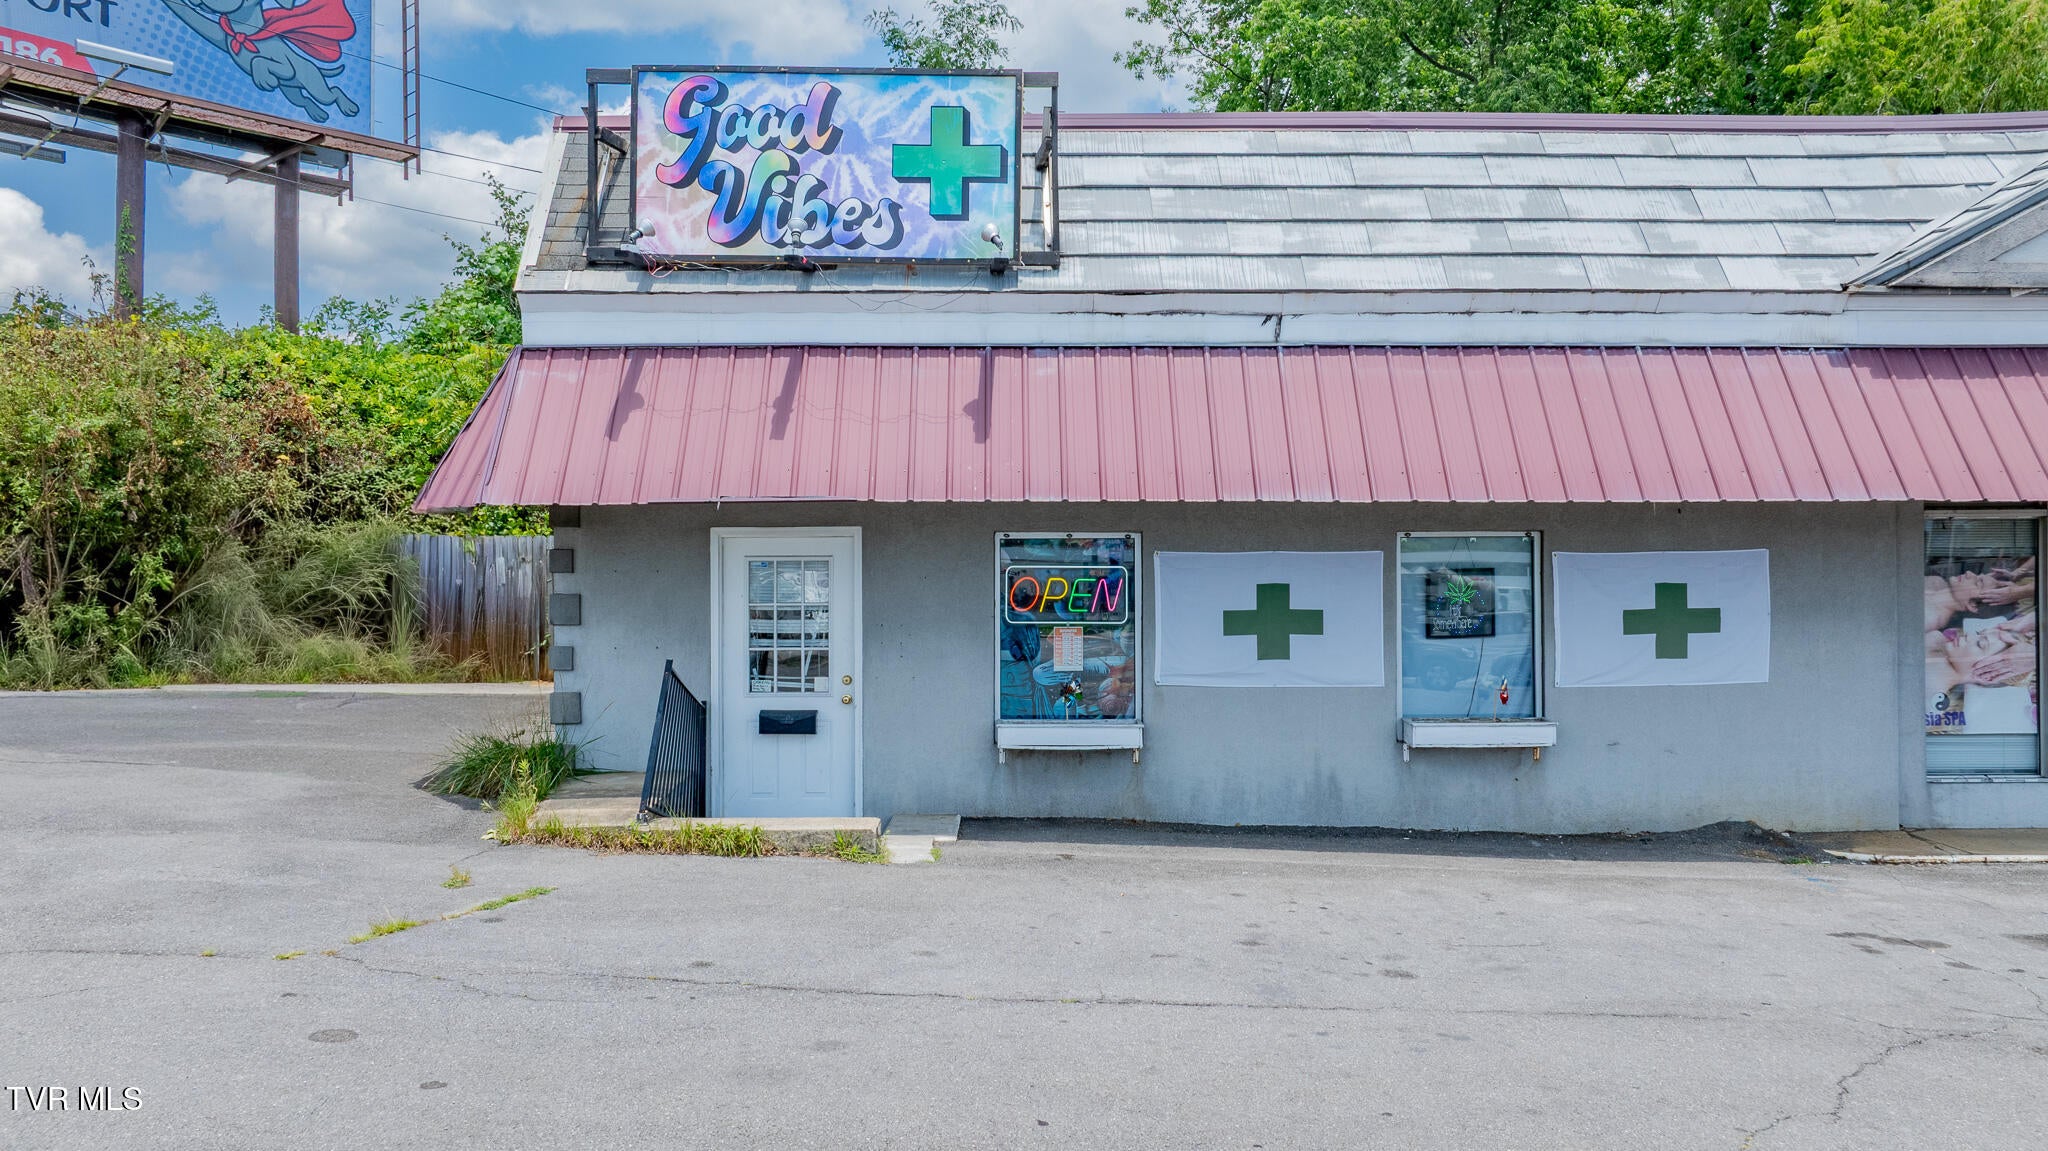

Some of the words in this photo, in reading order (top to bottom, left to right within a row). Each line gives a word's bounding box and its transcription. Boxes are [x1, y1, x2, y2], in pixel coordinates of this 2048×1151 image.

[656, 75, 844, 189] Good
[698, 149, 905, 250] Vibes
[1010, 576, 1123, 613] OPEN
[1944, 711, 1967, 726] SPA
